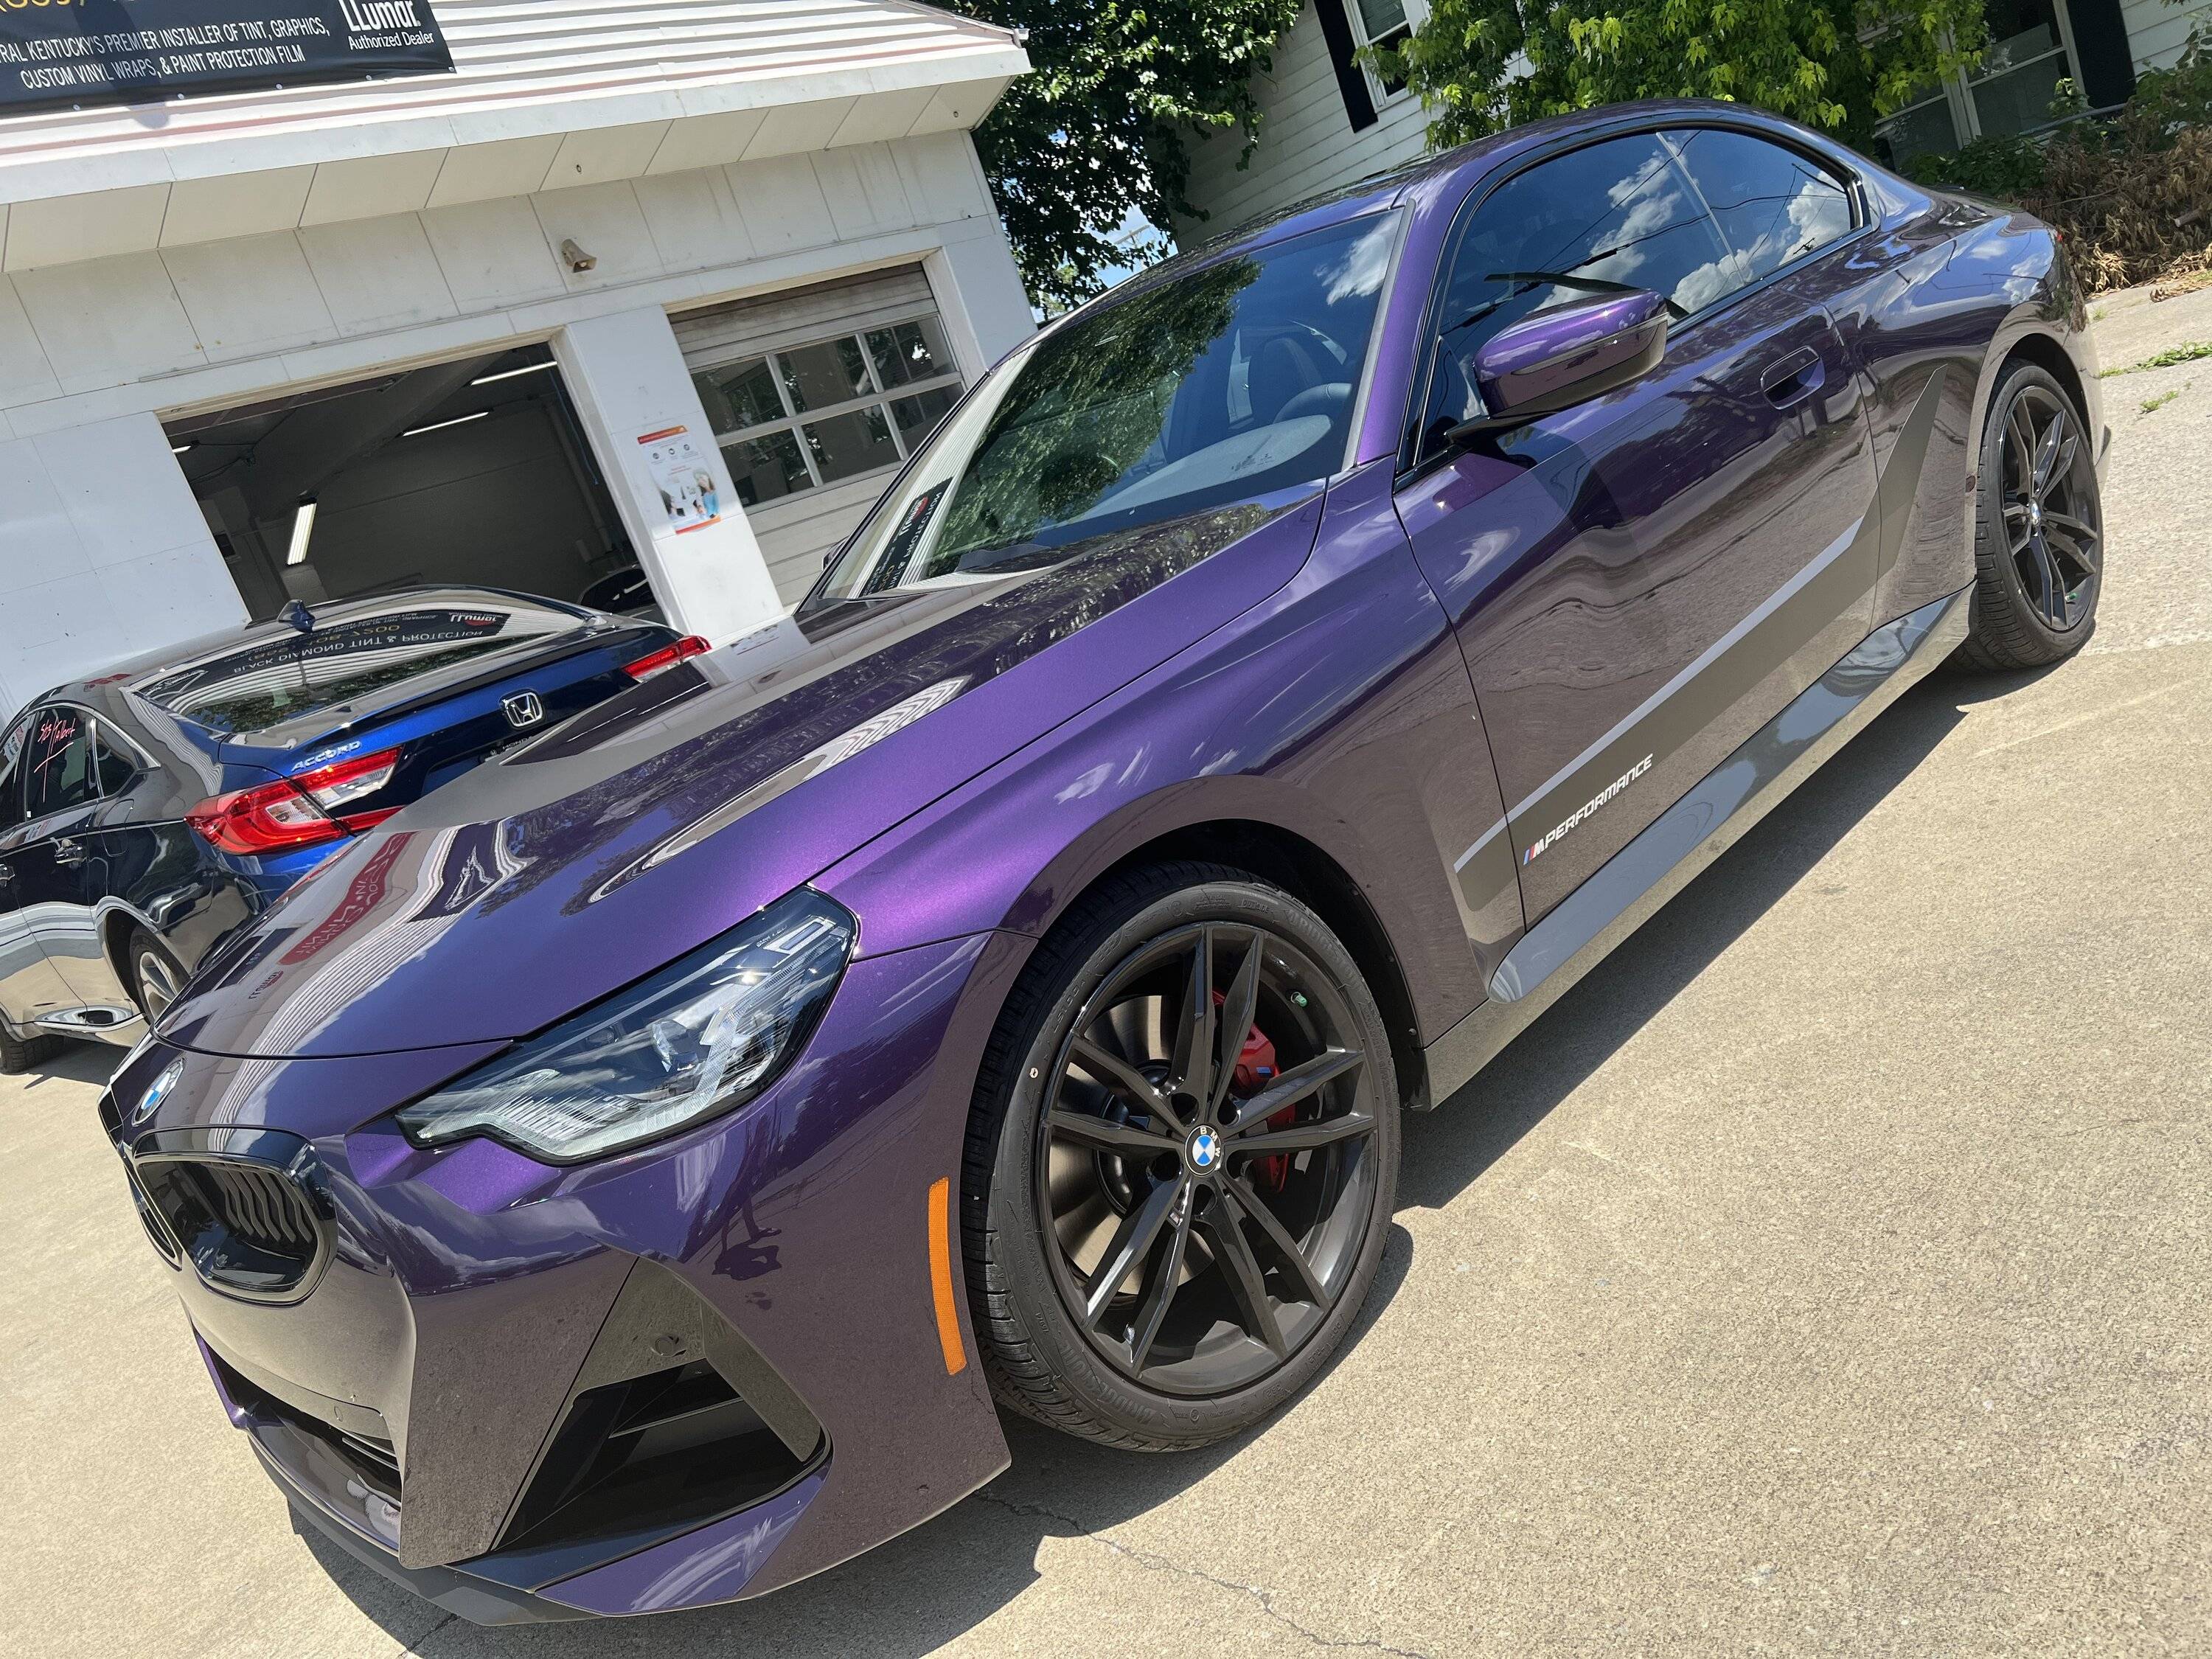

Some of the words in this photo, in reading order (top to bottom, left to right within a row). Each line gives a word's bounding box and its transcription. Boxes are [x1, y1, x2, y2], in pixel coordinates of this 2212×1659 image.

[0, 42, 28, 63] RAL
[26, 35, 105, 61] KENTUCKY'S
[103, 30, 161, 53] PREMIER
[159, 24, 224, 48] INSTALLER
[223, 23, 240, 42] OF
[239, 20, 272, 41] TINT,
[269, 16, 330, 38] GRAPHICS,
[348, 32, 402, 50] Authorized
[401, 30, 434, 46] Dealer
[20, 66, 77, 89] CUSTOM
[73, 63, 114, 85] VINYL
[111, 58, 161, 80] WRAPS,
[159, 56, 173, 74] &
[170, 52, 207, 74] PAINT
[206, 46, 279, 70] PROTECTION
[276, 44, 306, 64] FILM
[291, 740, 362, 772] ACCORD
[1544, 753, 1654, 849] PERFORMANCE
[1200, 1127, 1221, 1158] BMW
